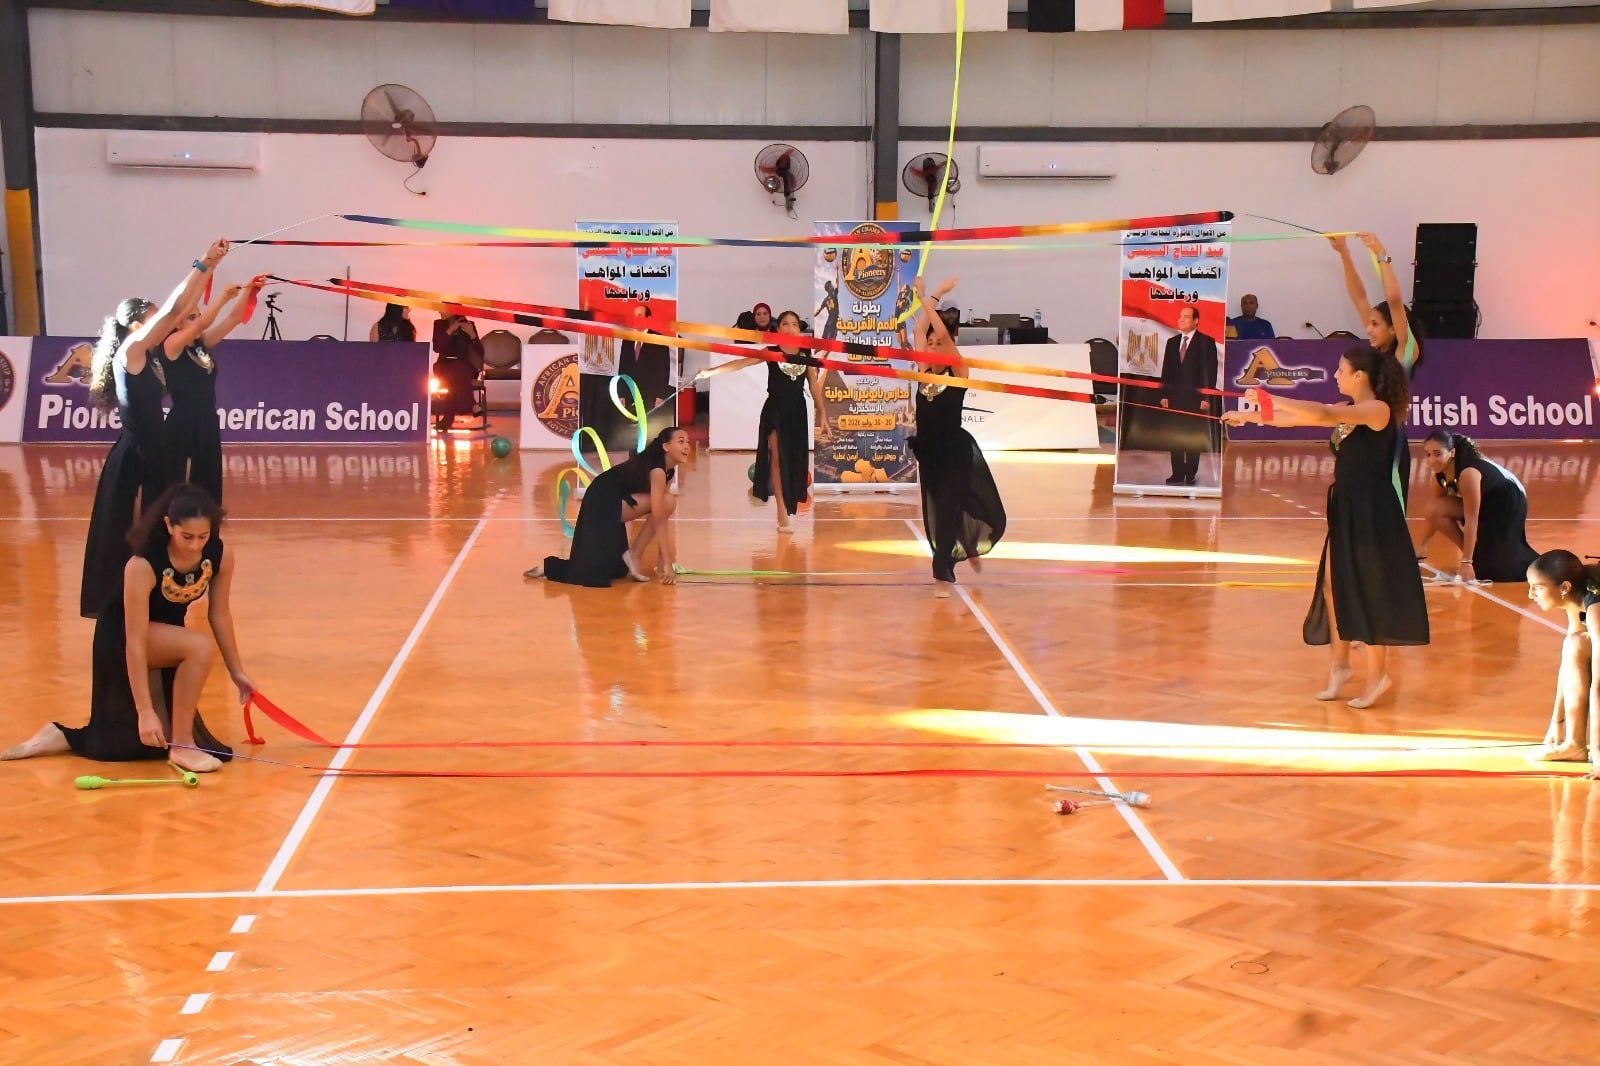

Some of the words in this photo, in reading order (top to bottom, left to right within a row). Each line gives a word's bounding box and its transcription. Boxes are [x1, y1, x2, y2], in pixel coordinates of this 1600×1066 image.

[584, 265, 626, 281] المواهب
[629, 265, 671, 278] اكتشاف
[858, 267, 887, 280] Pioneers
[1128, 266, 1173, 282] المواهب
[1177, 266, 1221, 279] اكتشاف
[603, 286, 651, 302] ورعايتها
[1149, 287, 1199, 303] ورعايتها
[852, 301, 881, 317] بطولة
[1265, 370, 1309, 379] PIONEERS
[884, 388, 910, 402] مدارس
[216, 401, 316, 431] erican
[325, 401, 419, 431] School
[1407, 395, 1478, 426] itish
[1488, 394, 1592, 426] School
